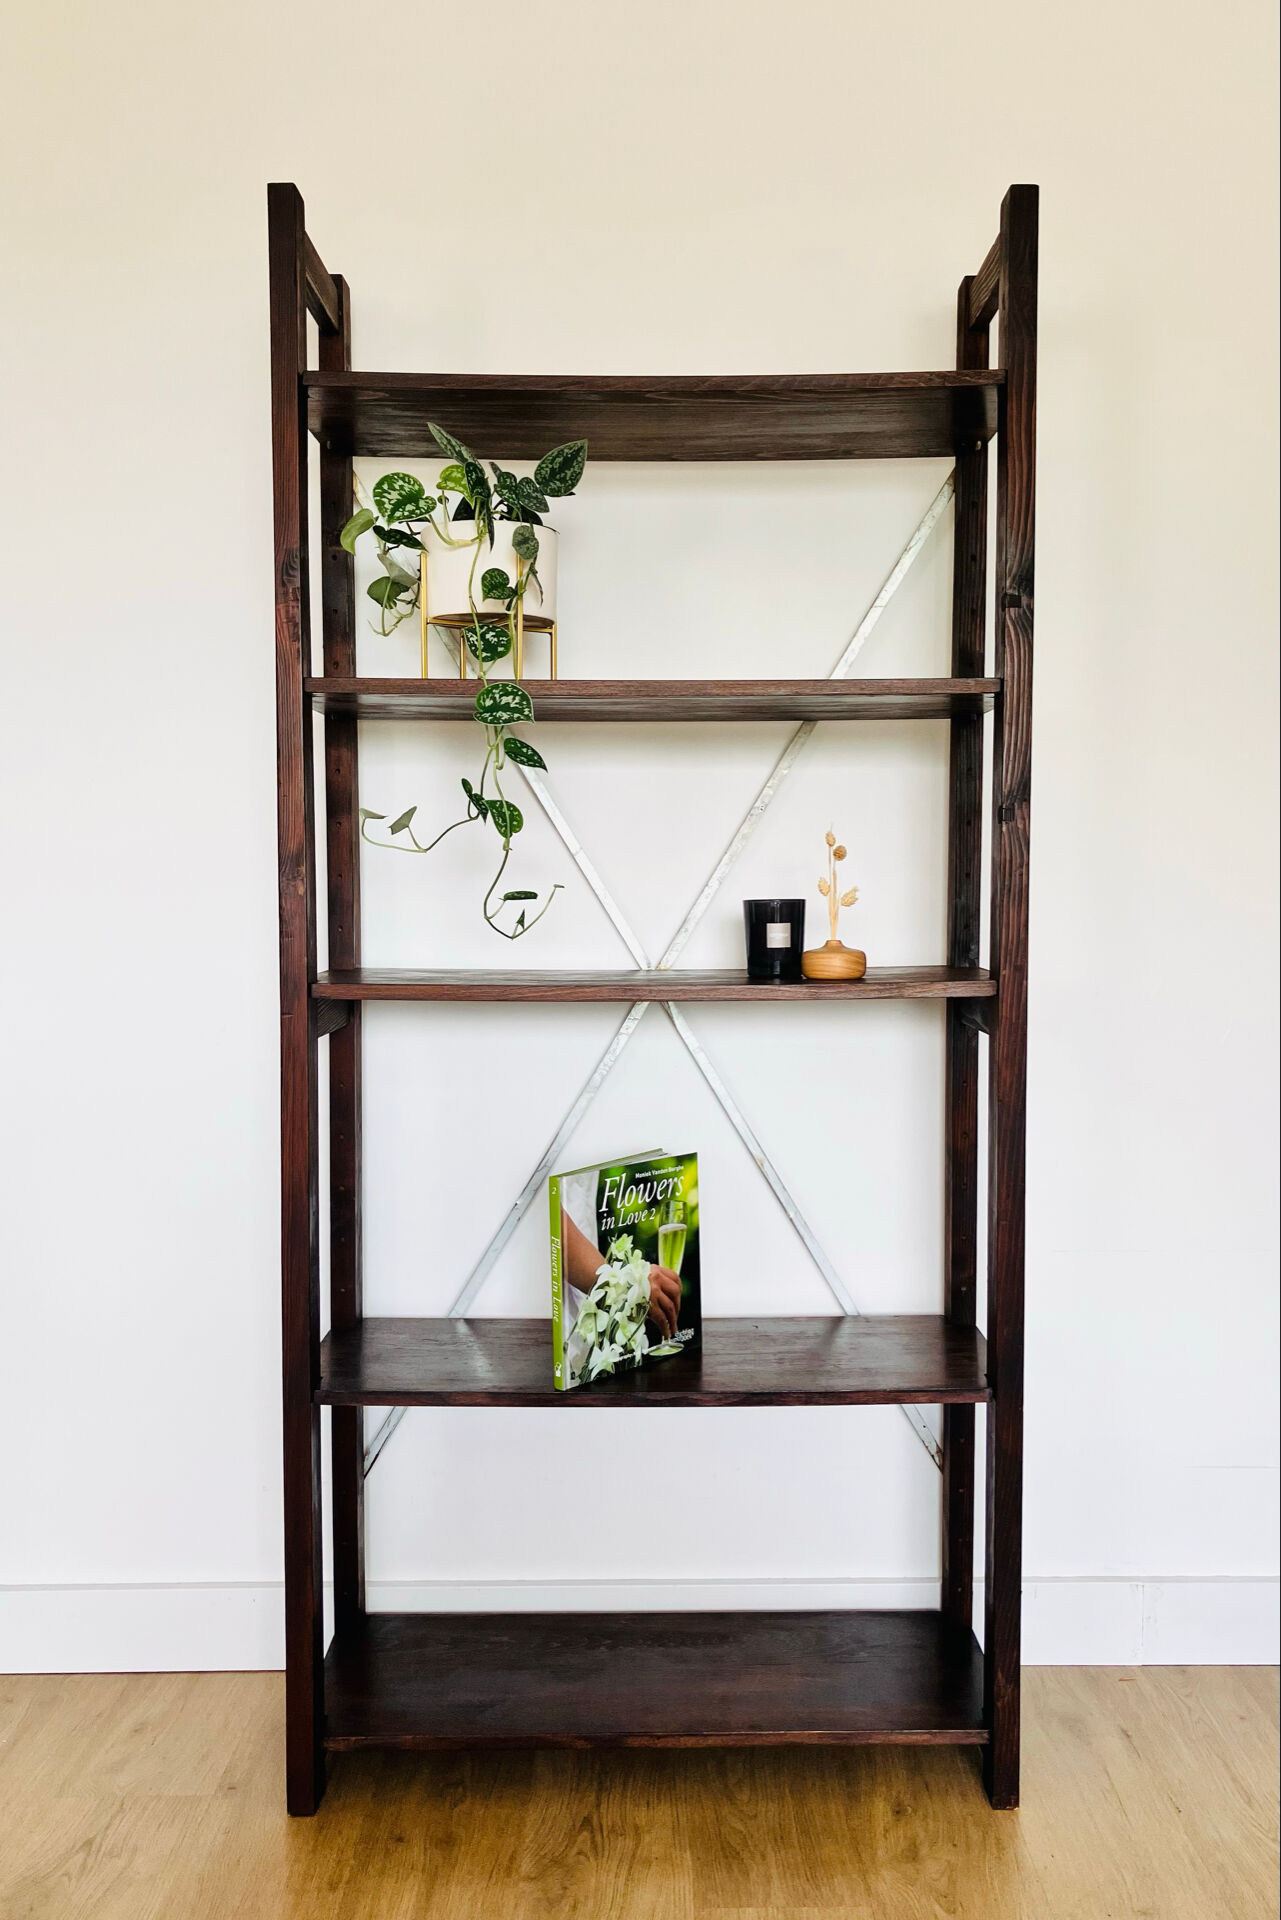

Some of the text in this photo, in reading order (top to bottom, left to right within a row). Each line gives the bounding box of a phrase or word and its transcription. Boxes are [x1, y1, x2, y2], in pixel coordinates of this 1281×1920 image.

[598, 1172, 685, 1212] Flowers
[601, 1207, 656, 1231] in Love 2
[551, 1235, 561, 1322] Flowers in Love
